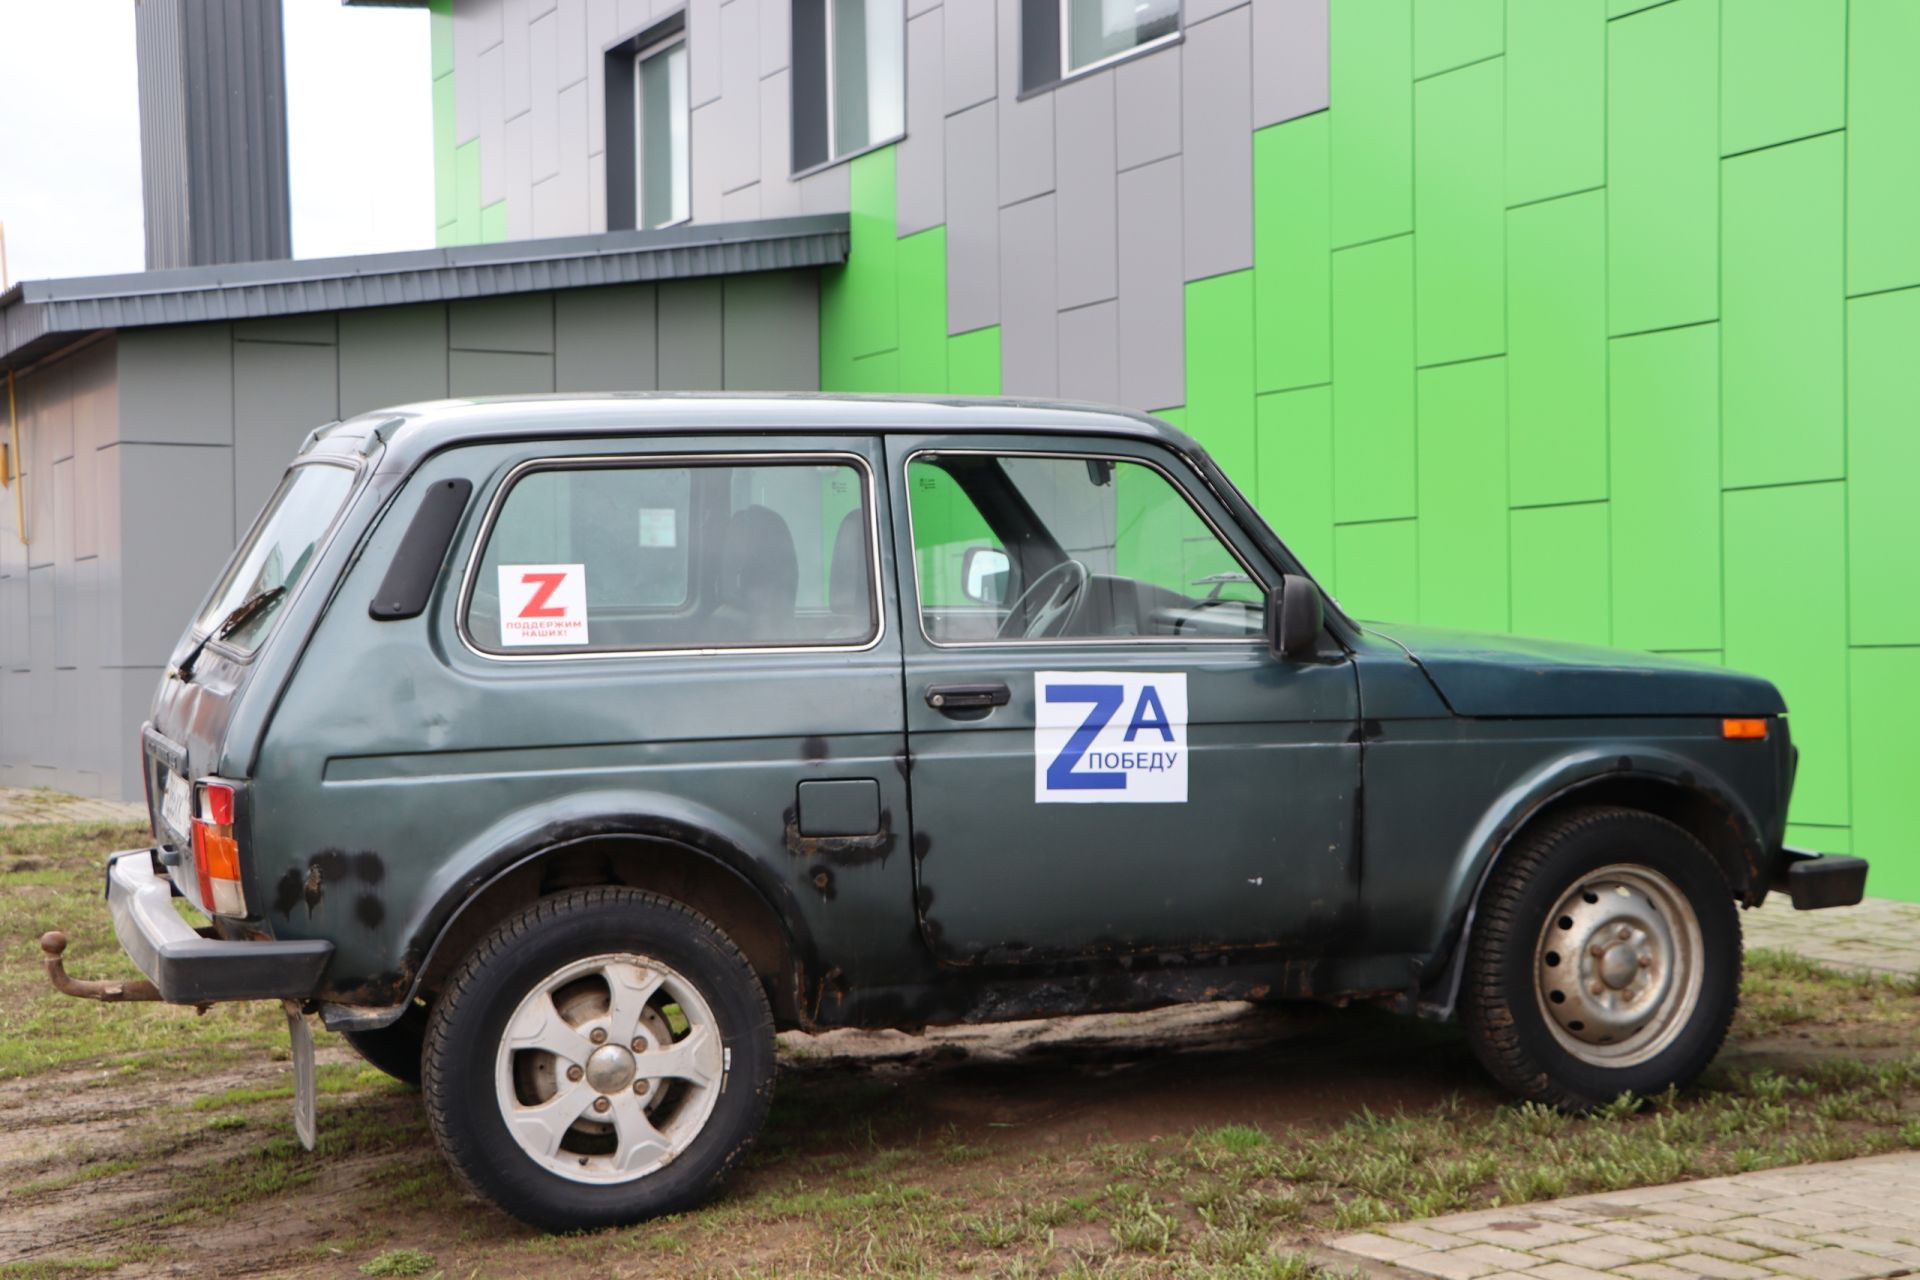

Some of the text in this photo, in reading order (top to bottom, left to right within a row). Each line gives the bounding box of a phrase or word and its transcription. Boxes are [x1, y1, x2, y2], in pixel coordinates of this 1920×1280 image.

[517, 573, 568, 618] Z
[506, 621, 582, 630] ПОДДЕРЖИМ
[522, 629, 568, 638] НАШИХ!
[1089, 752, 1178, 773] ПОБЕДУ
